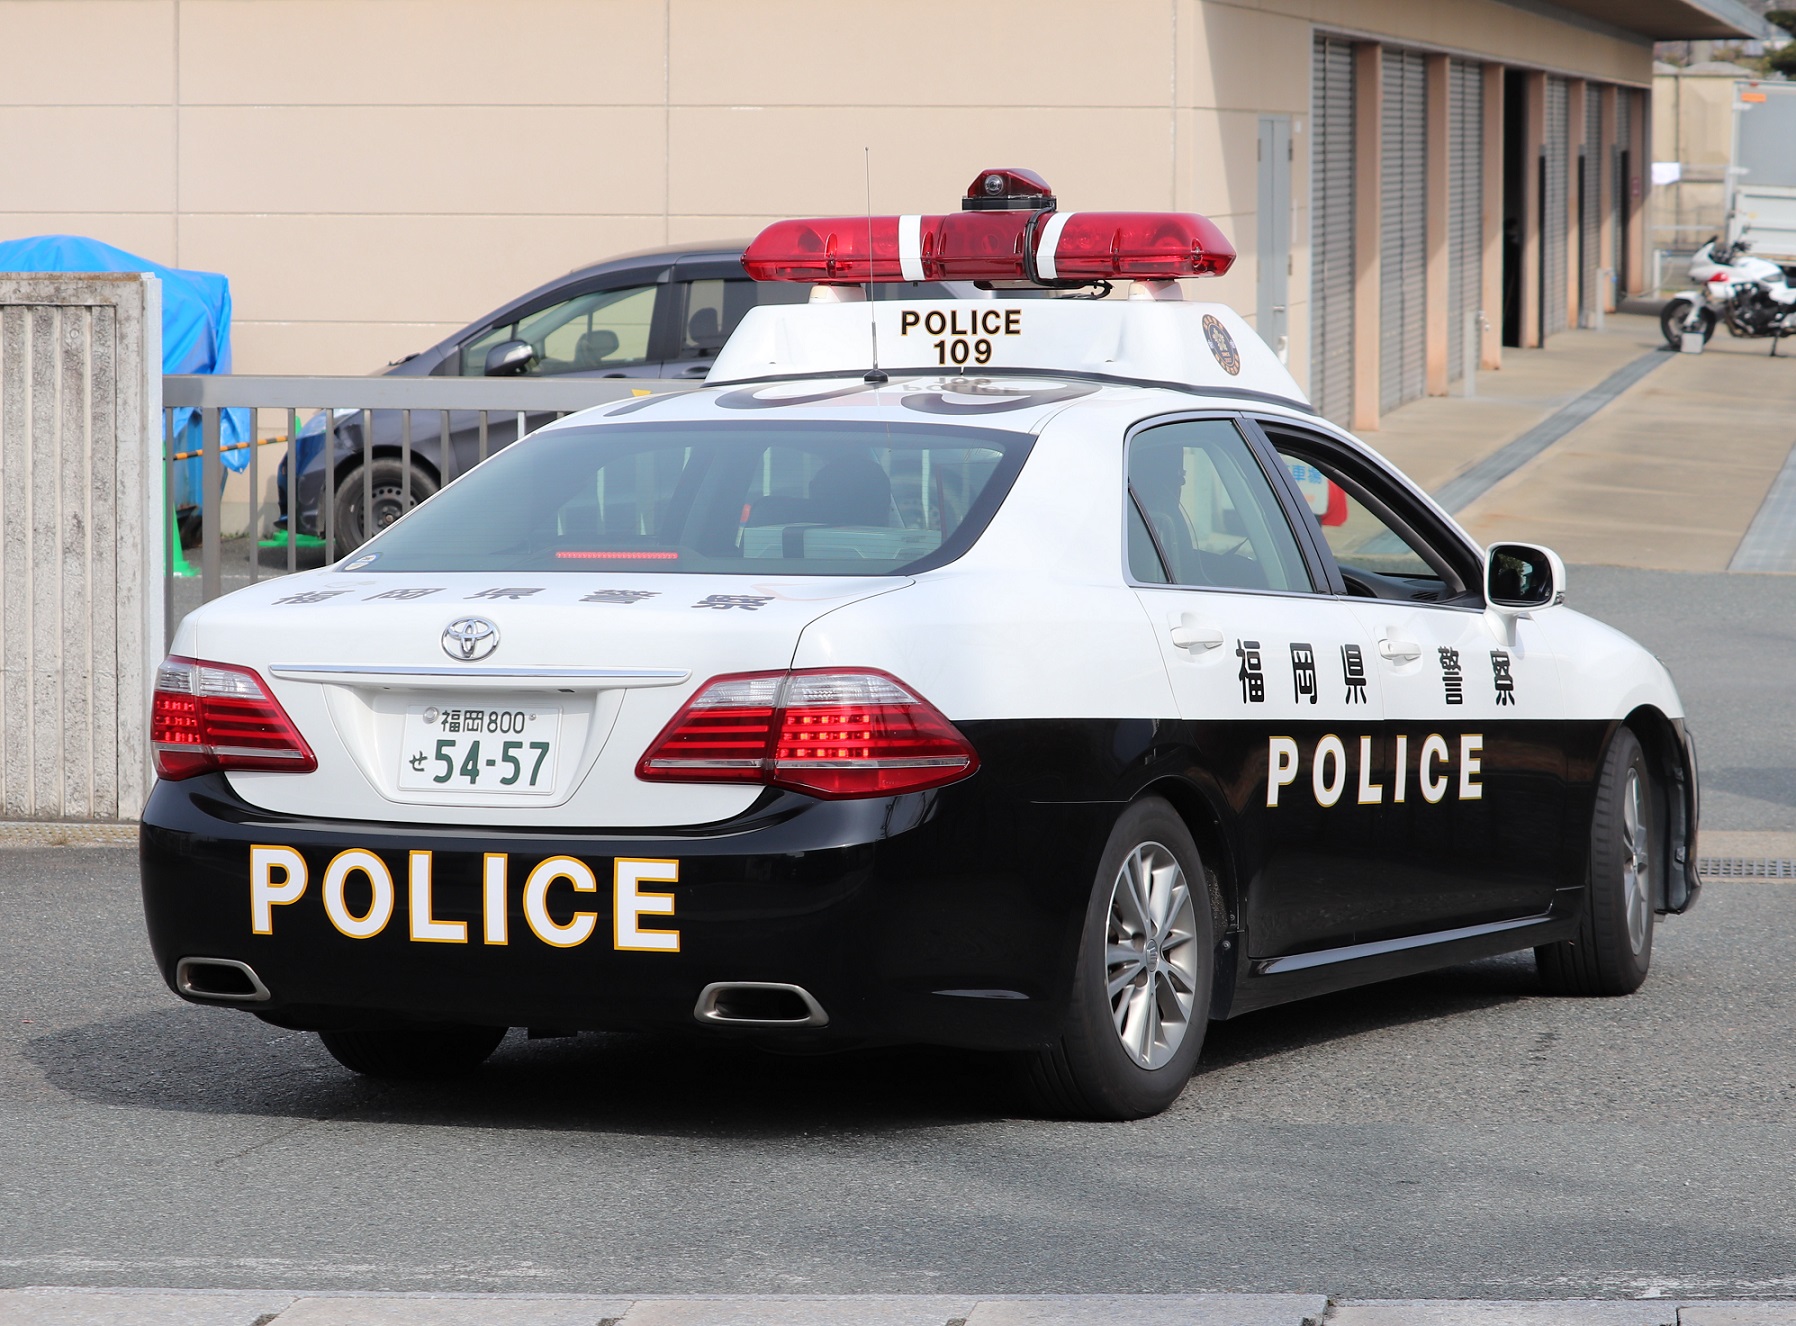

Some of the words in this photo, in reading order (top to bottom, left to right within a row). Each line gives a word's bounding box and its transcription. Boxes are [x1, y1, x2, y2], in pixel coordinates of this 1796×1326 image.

[901, 309, 1022, 336] POLICE
[933, 338, 992, 365] 109
[409, 750, 428, 772] せ
[432, 739, 550, 786] 54-57
[1266, 733, 1484, 808] POLICE
[250, 844, 680, 953] POLICE
